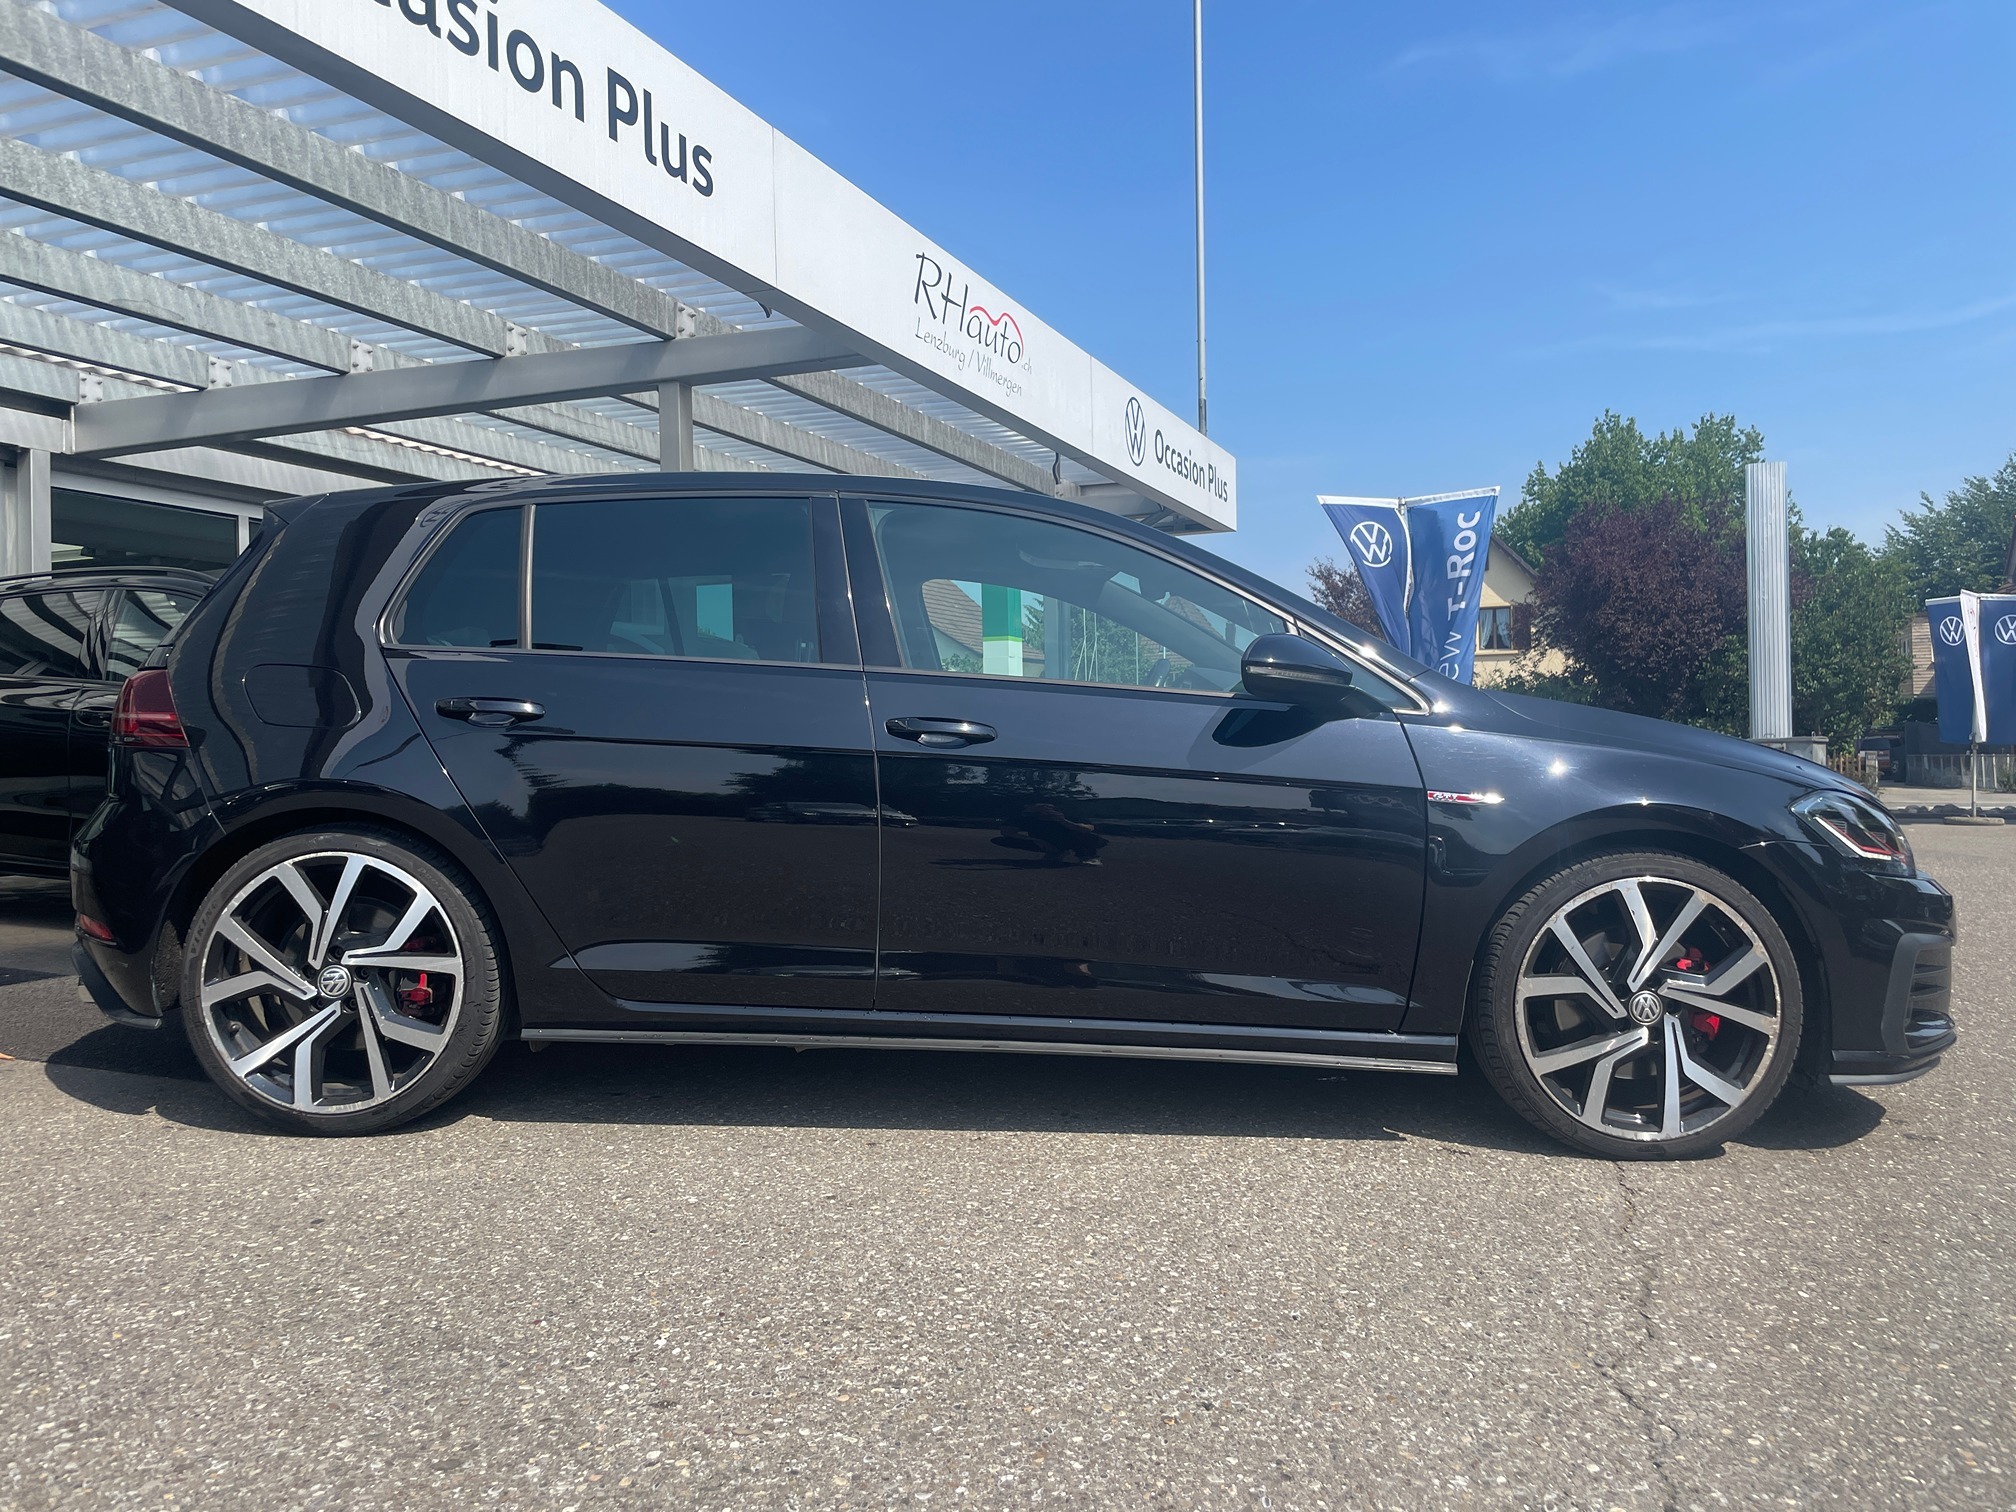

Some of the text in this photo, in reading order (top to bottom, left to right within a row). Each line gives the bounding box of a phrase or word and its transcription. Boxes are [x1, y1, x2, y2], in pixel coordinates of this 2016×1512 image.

[374, 0, 714, 197] asion Plus
[915, 317, 966, 371] Lenzburg
[977, 351, 1022, 398] Villmergen
[1155, 429, 1228, 503] Occasion Plus
[1439, 634, 1462, 680] ew
